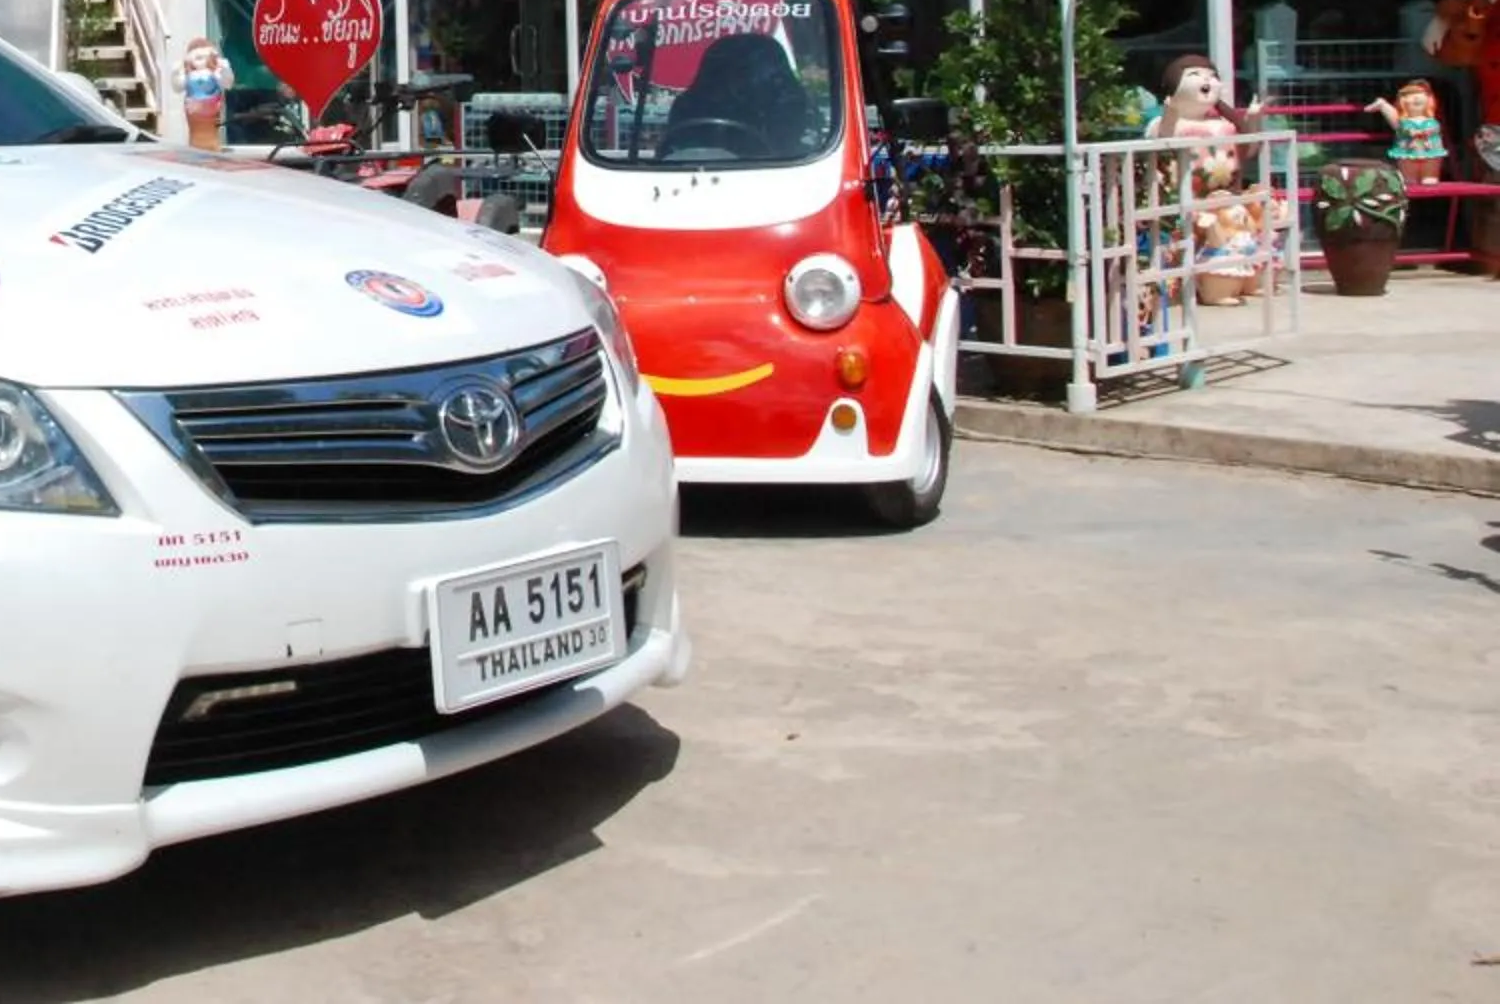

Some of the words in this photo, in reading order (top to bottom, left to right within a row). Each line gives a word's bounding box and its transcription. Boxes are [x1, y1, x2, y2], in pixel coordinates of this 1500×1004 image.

[49, 176, 196, 254] BRIDGESTONE
[469, 585, 512, 642] AA
[526, 562, 601, 624] 5151
[475, 629, 583, 682] THAILAND
